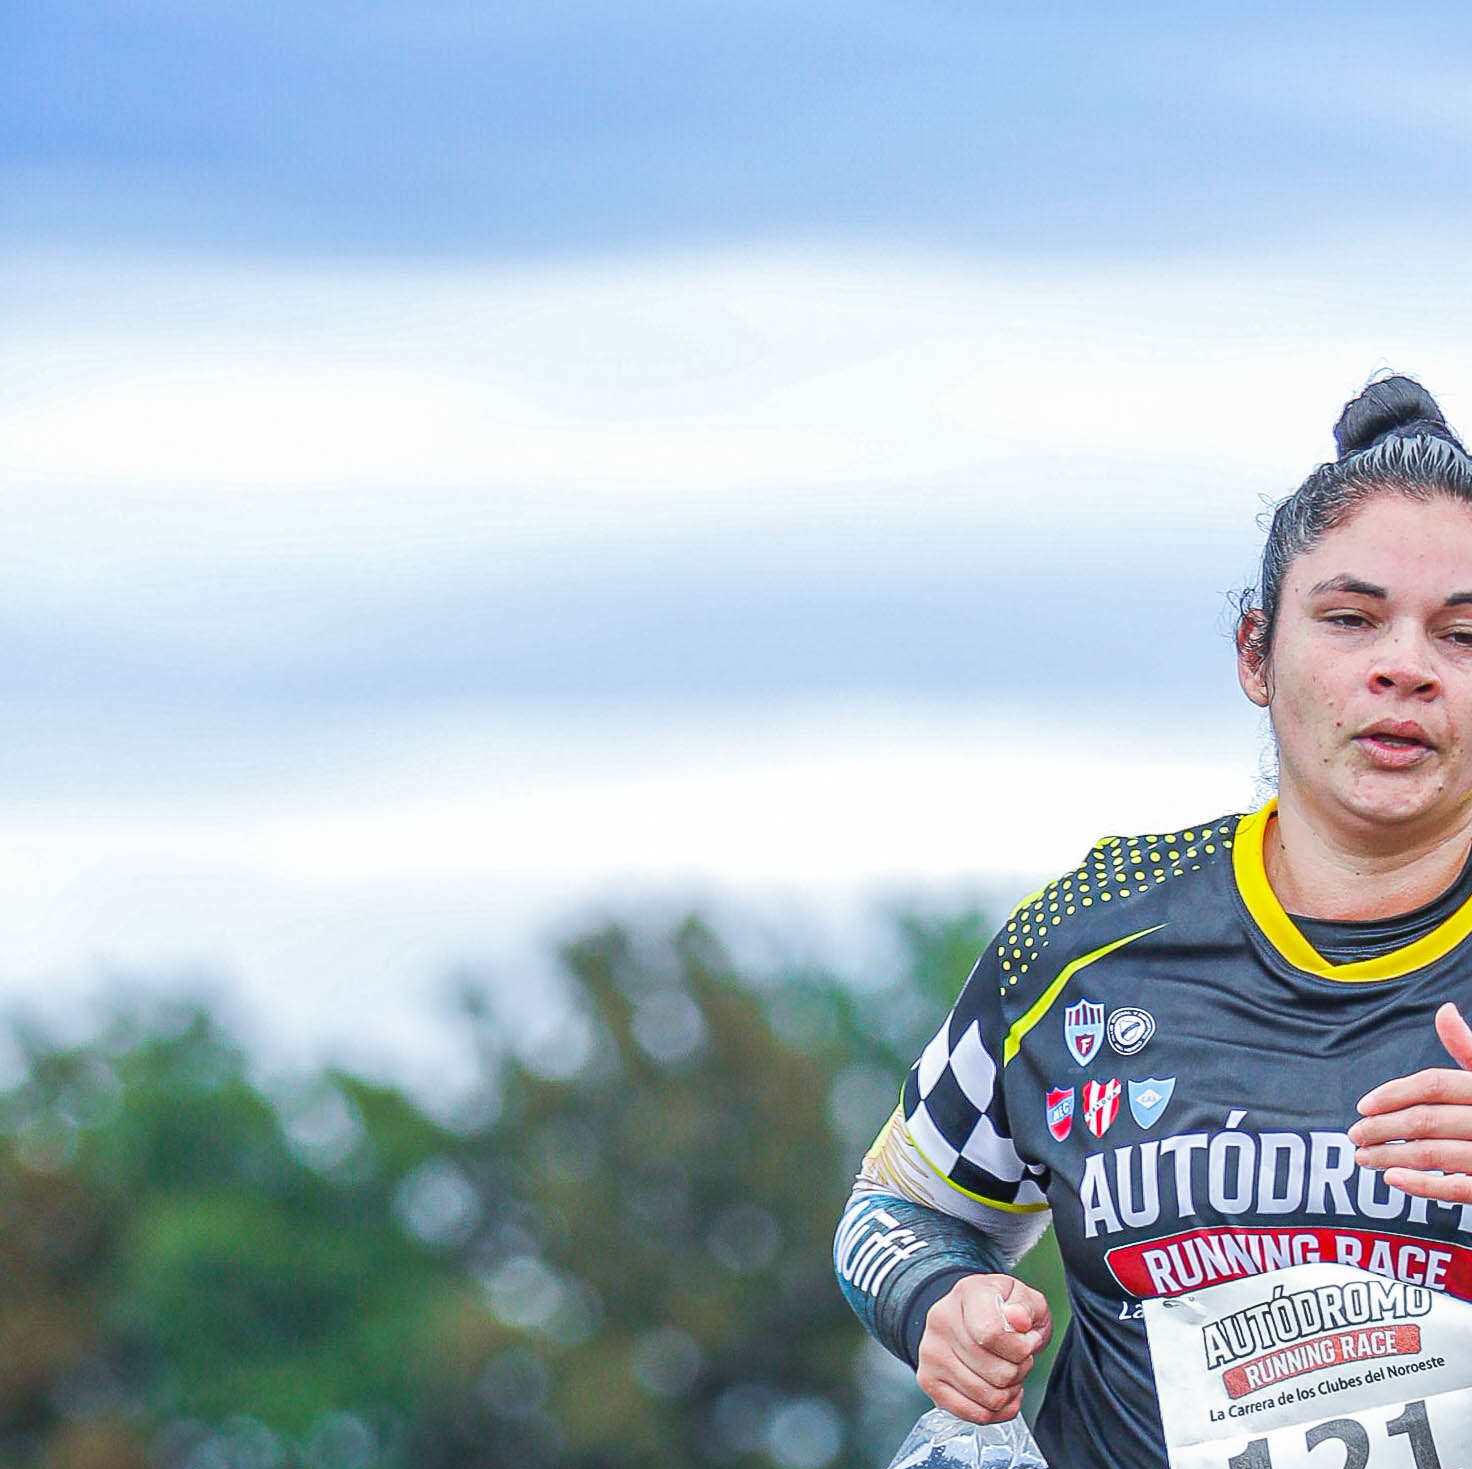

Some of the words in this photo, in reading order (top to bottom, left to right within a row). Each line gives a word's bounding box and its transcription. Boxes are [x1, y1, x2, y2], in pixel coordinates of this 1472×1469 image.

[1142, 1232, 1320, 1295] RUNNING
[1335, 1234, 1454, 1291] RACE
[1118, 1300, 1144, 1320] La
[1201, 1281, 1433, 1370] AUTÓDROMO
[1209, 1409, 1225, 1422] La
[1229, 1399, 1275, 1419] Carrera
[1278, 1391, 1294, 1407] de
[1296, 1387, 1316, 1402] los
[1317, 1376, 1363, 1396] Clubes
[1365, 1367, 1386, 1384] del
[1387, 1355, 1446, 1379] Noroeste
[1243, 1338, 1336, 1390] RUNNING
[1340, 1330, 1399, 1360] RACE
